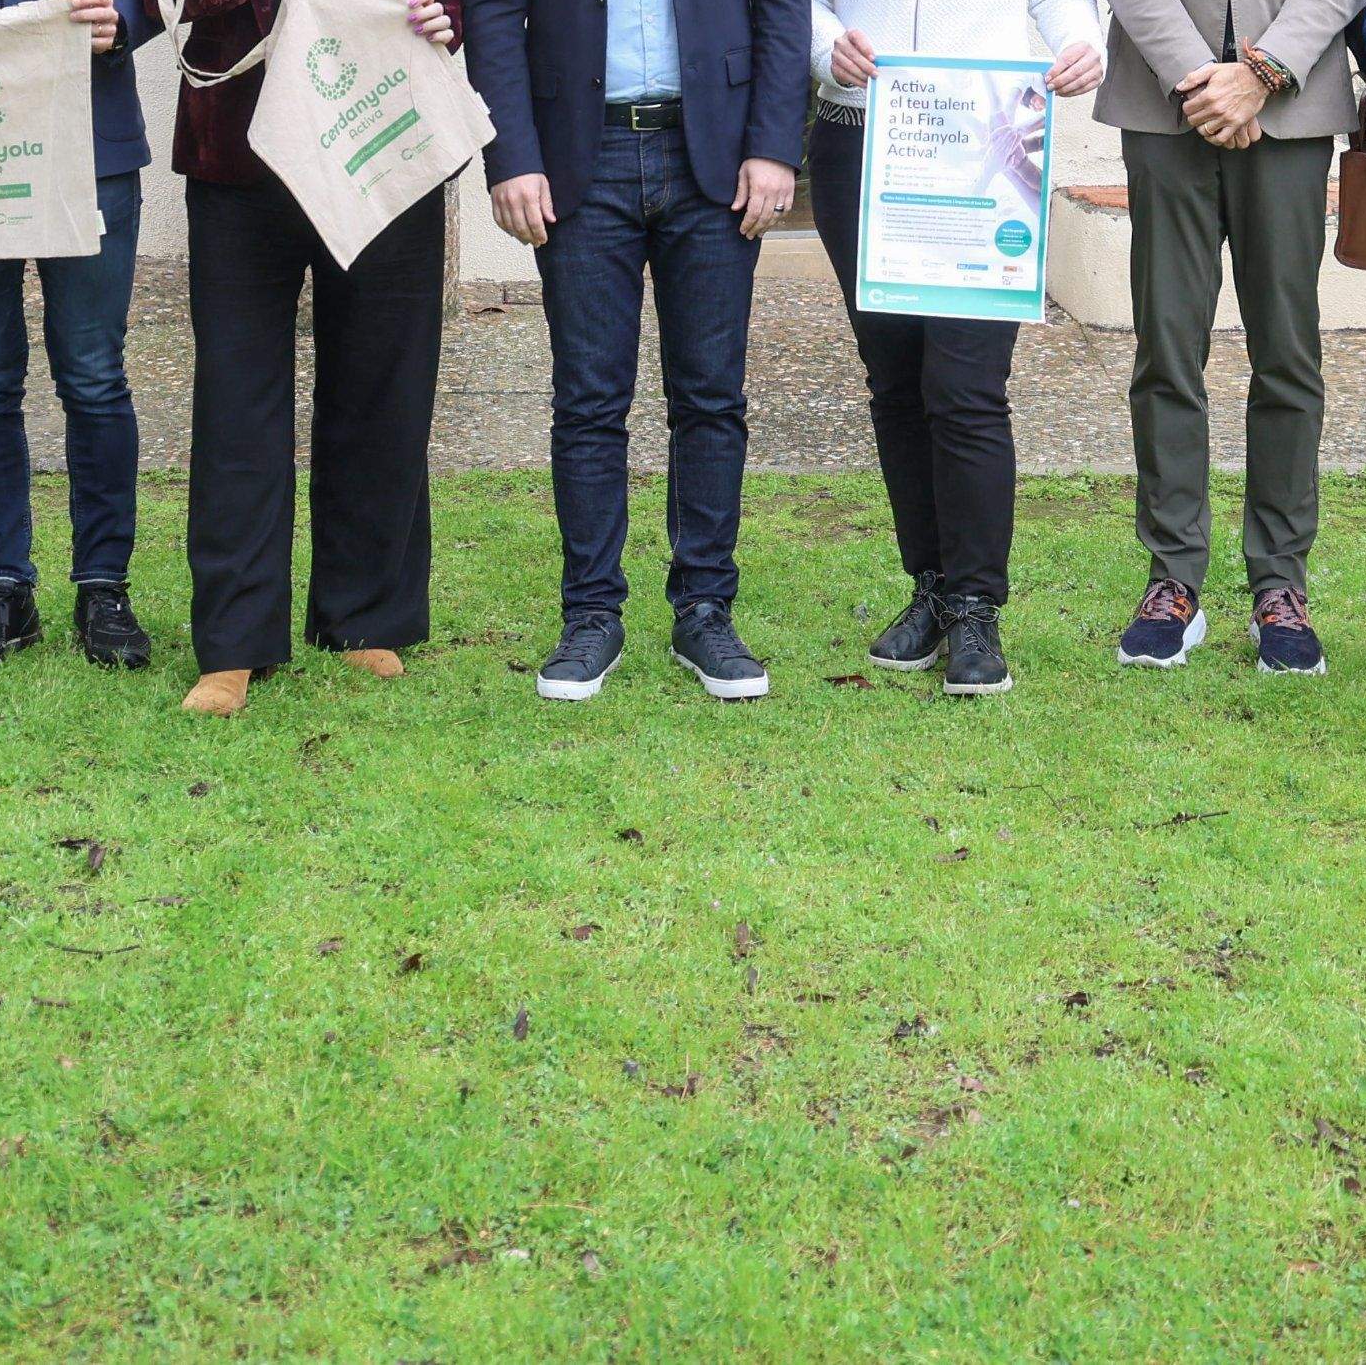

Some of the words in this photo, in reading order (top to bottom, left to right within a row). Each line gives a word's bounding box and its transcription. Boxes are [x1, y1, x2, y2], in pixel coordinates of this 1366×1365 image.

[890, 79, 935, 93] Activa
[320, 68, 407, 150] Cerdanyola
[890, 97, 901, 108] el
[907, 98, 929, 109] teu
[934, 97, 976, 111] talent
[349, 109, 383, 139] Activa
[889, 116, 897, 124] a
[901, 113, 913, 125] la
[918, 113, 944, 126] Fira
[888, 128, 969, 145] Cerdanyola
[887, 143, 937, 159] Activa!
